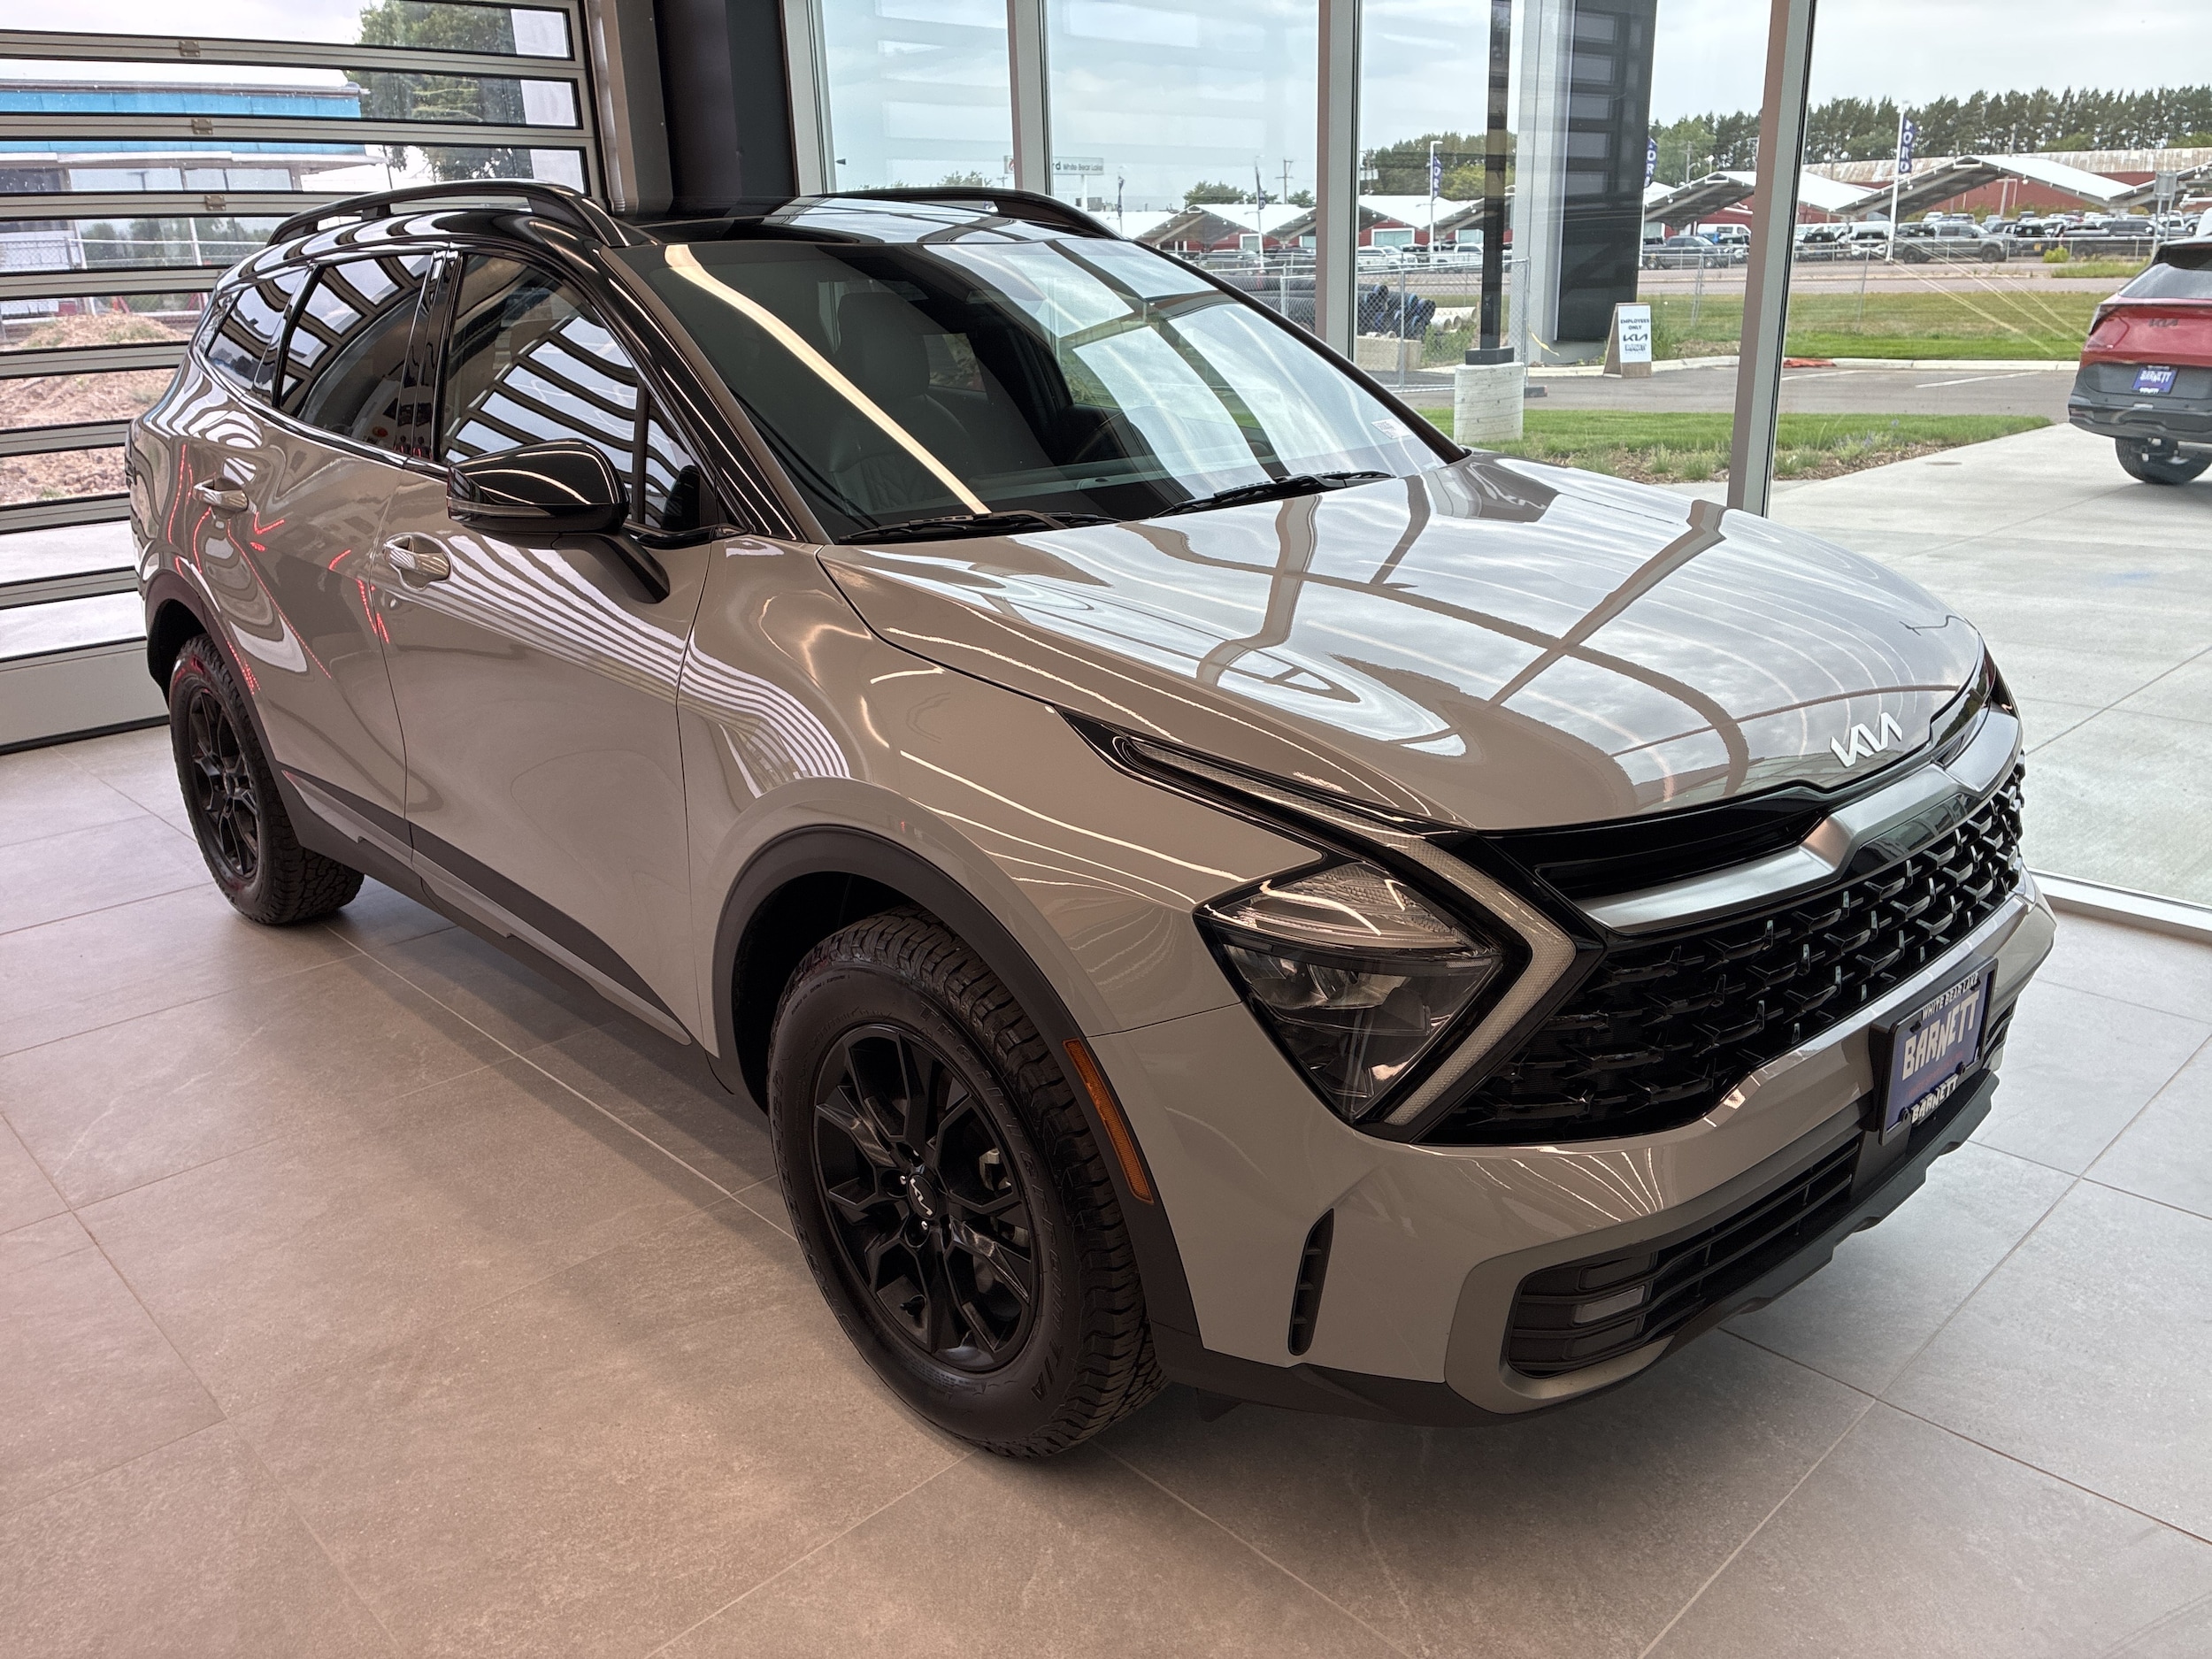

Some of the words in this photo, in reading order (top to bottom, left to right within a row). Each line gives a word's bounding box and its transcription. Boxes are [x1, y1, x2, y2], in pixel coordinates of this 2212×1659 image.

[1830, 712, 1902, 768] KIA
[1921, 998, 1944, 1021] WHITE
[1944, 983, 1963, 1007] BEAR
[1962, 972, 1979, 995] LAKE
[1901, 990, 1980, 1081] BARNETT
[1911, 1075, 1958, 1124] BARNETT
